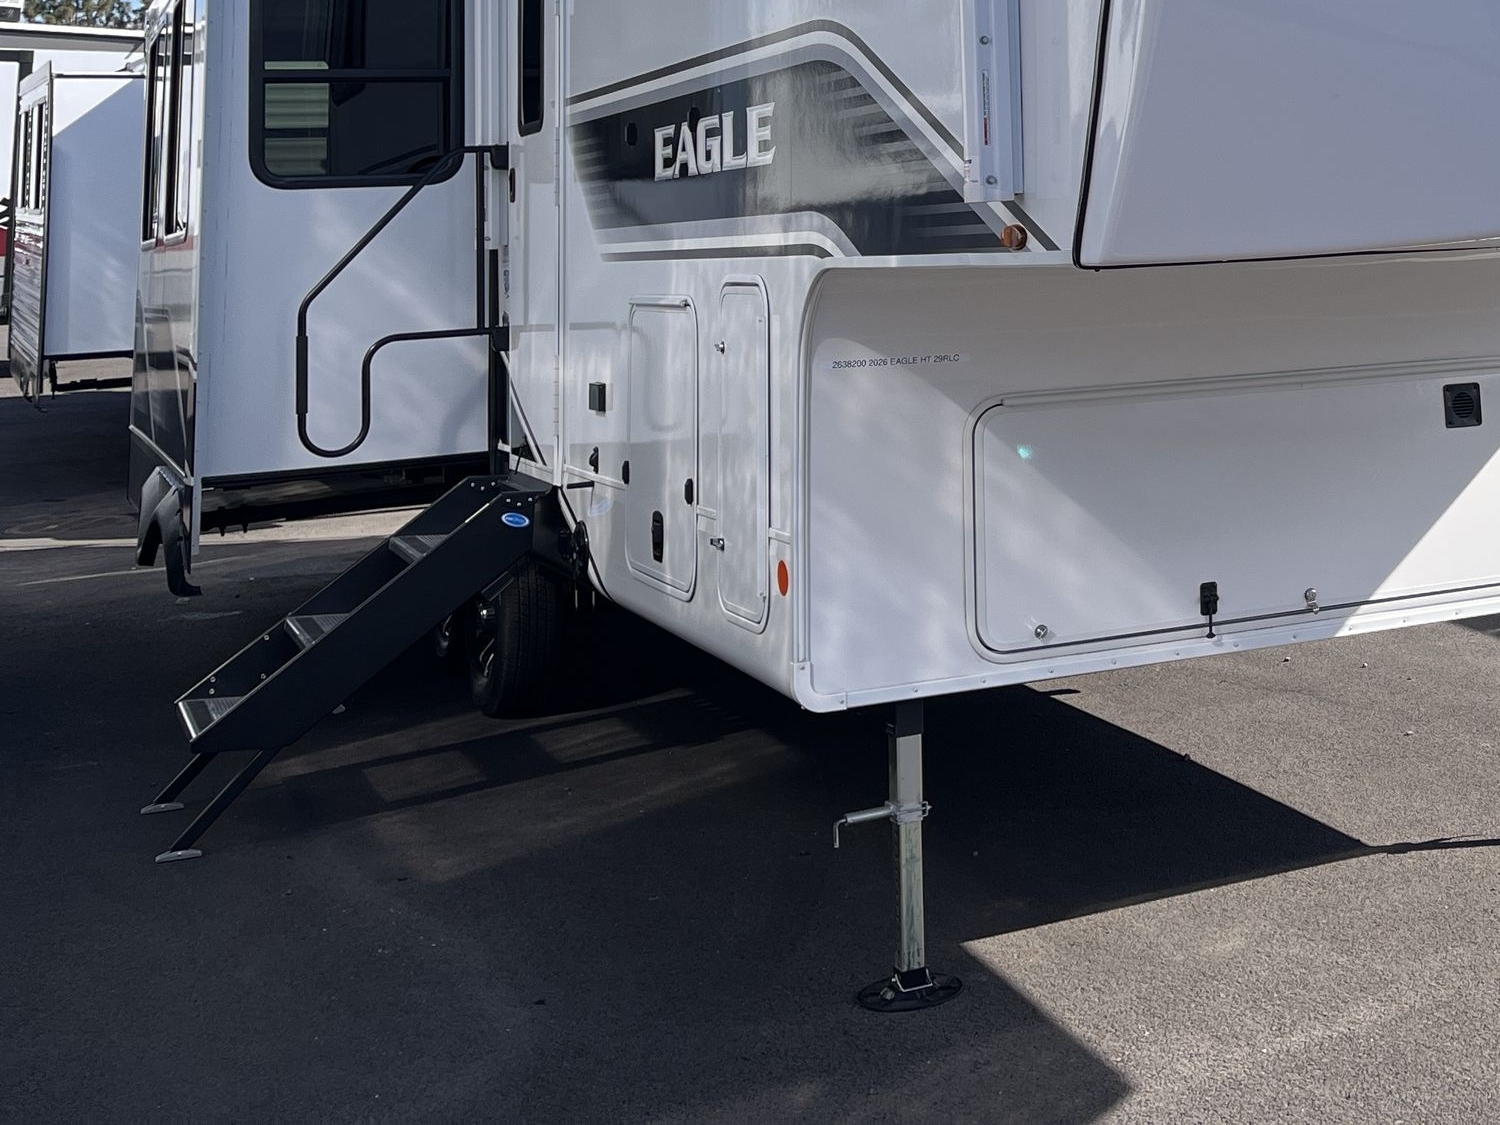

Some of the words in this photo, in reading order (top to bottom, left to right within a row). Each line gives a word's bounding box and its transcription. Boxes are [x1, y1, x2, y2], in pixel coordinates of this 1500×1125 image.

[654, 102, 776, 182] EAGLE
[832, 359, 867, 369] 2638200
[868, 358, 888, 367] 2026
[890, 356, 918, 366] EAGLE
[920, 355, 932, 364] HT
[933, 353, 960, 363] 29RLC
